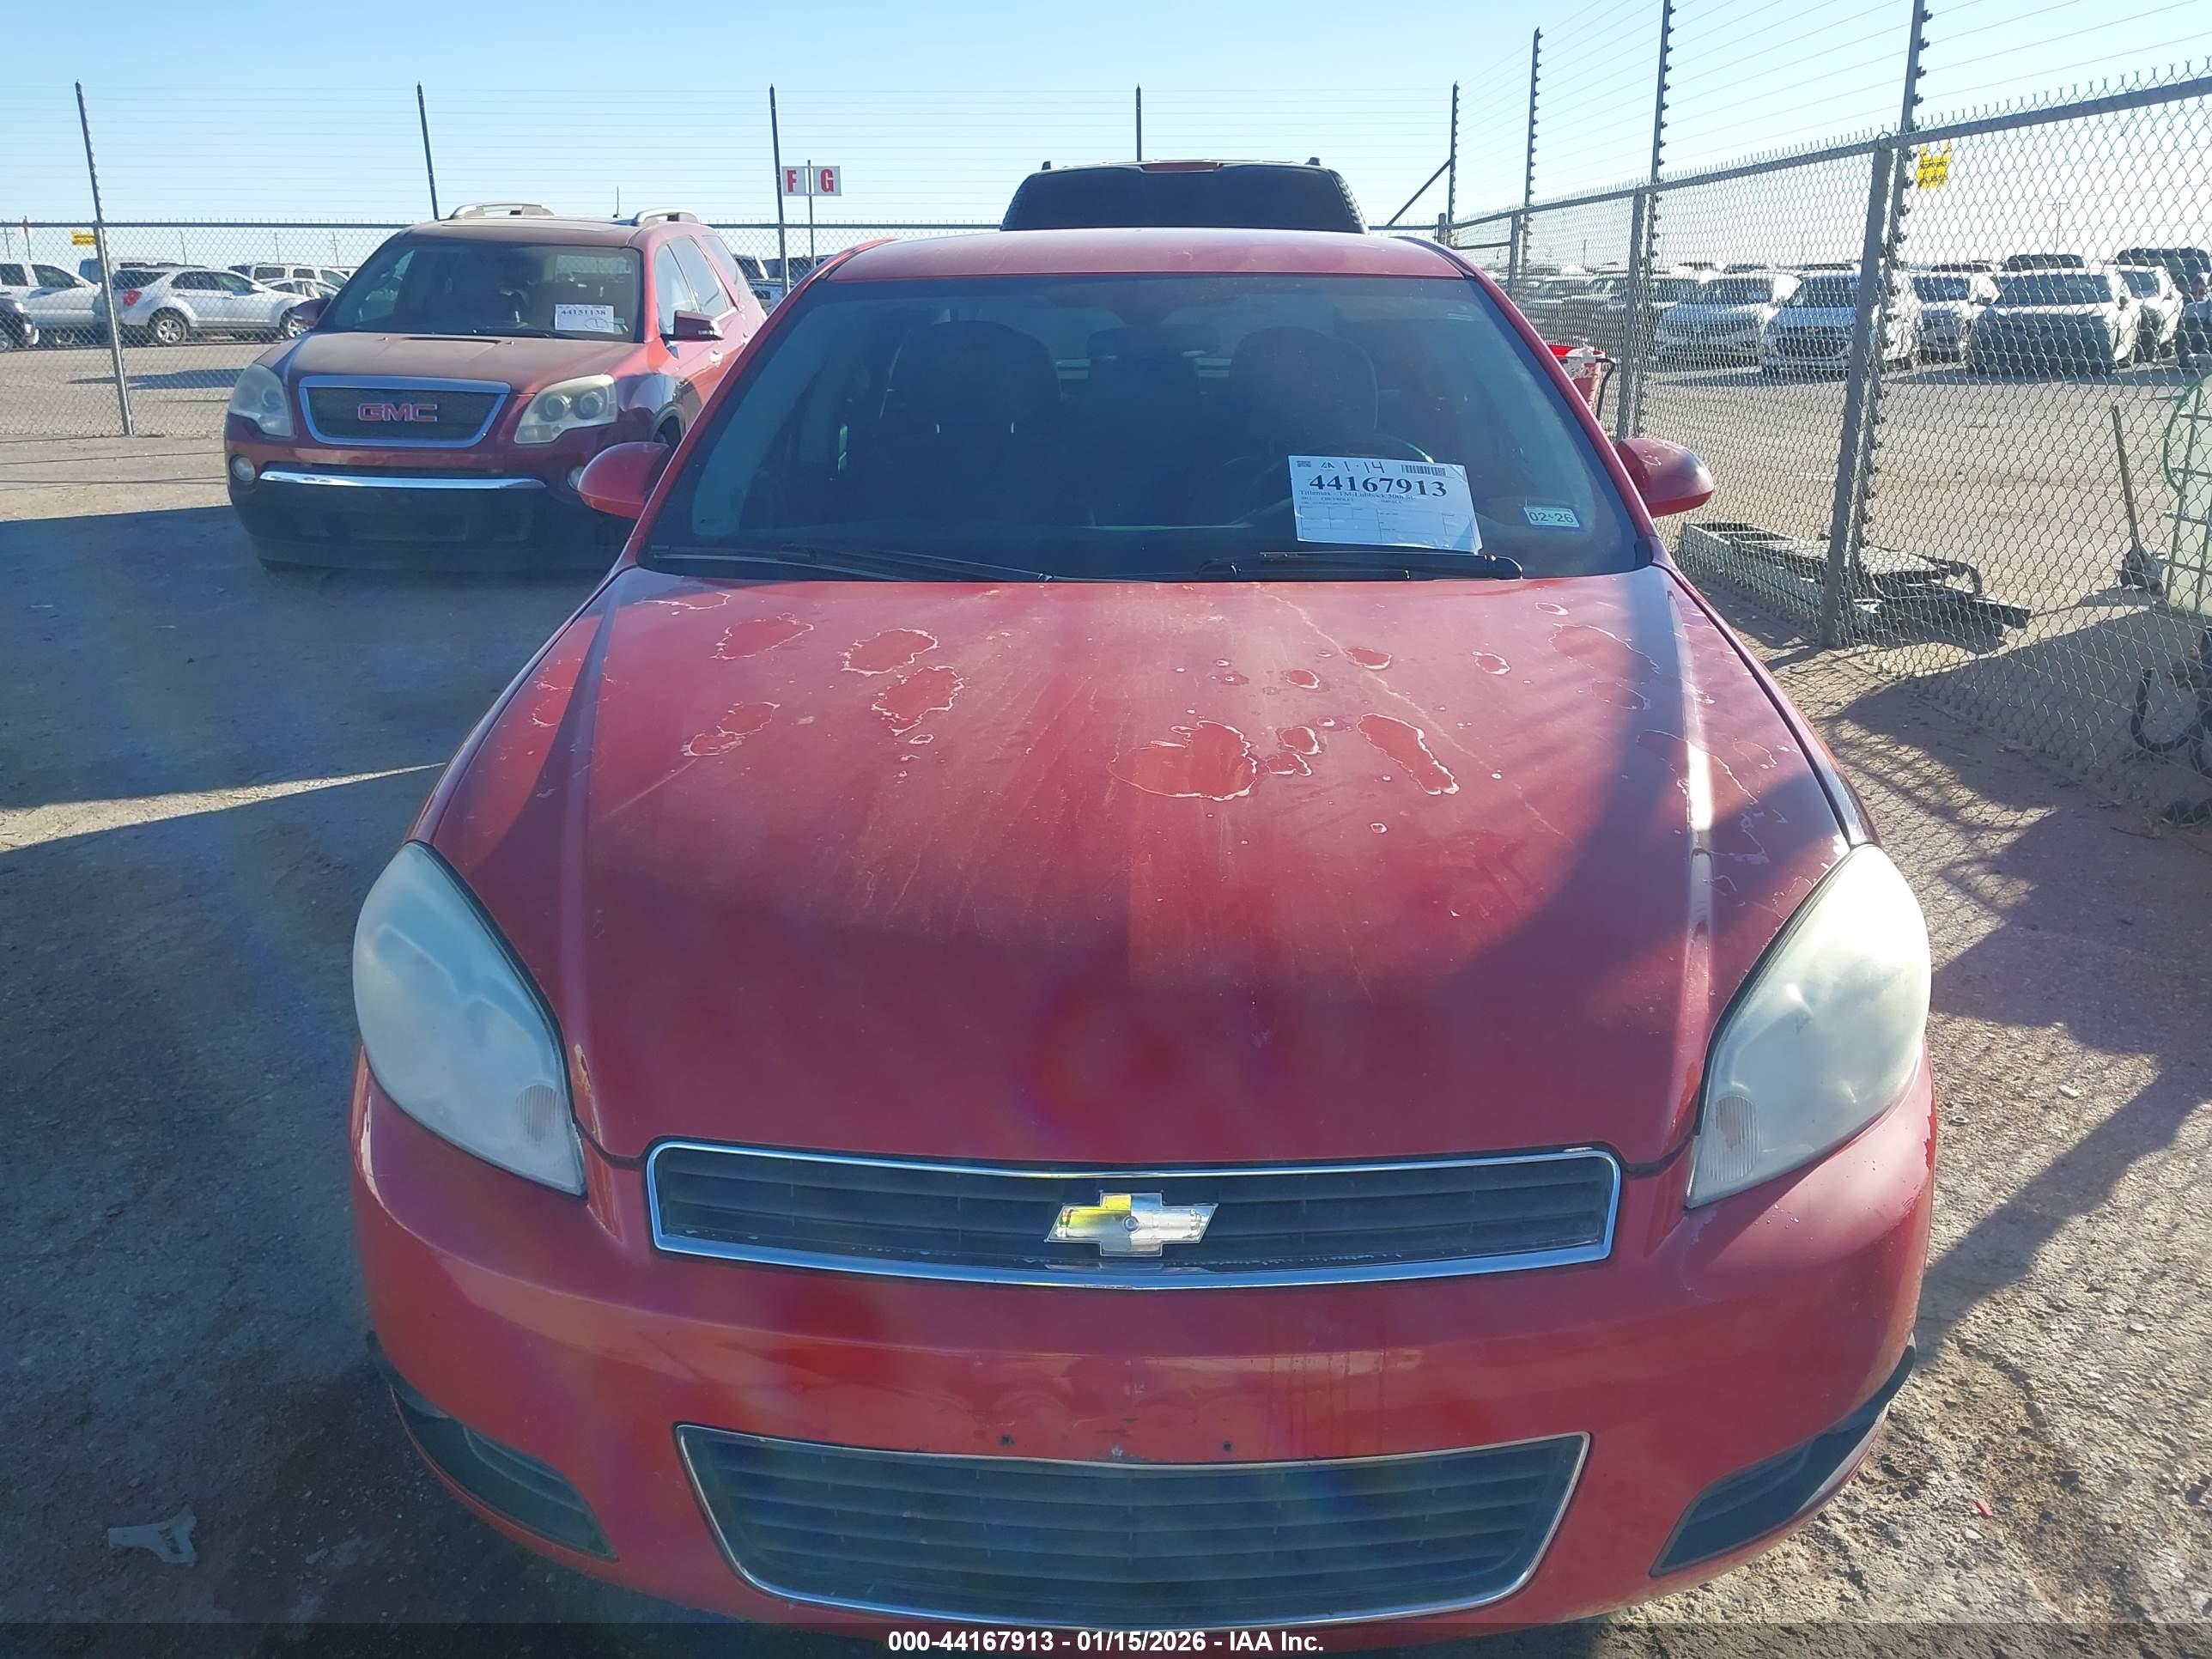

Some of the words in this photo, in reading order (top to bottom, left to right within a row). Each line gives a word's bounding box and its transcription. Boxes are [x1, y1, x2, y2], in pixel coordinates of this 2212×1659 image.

[787, 169, 797, 193] F
[820, 168, 834, 193] G
[357, 403, 438, 422] GMC
[1309, 474, 1448, 498] 44167913
[1528, 512, 1549, 521] 02
[1554, 513, 1574, 523] 26
